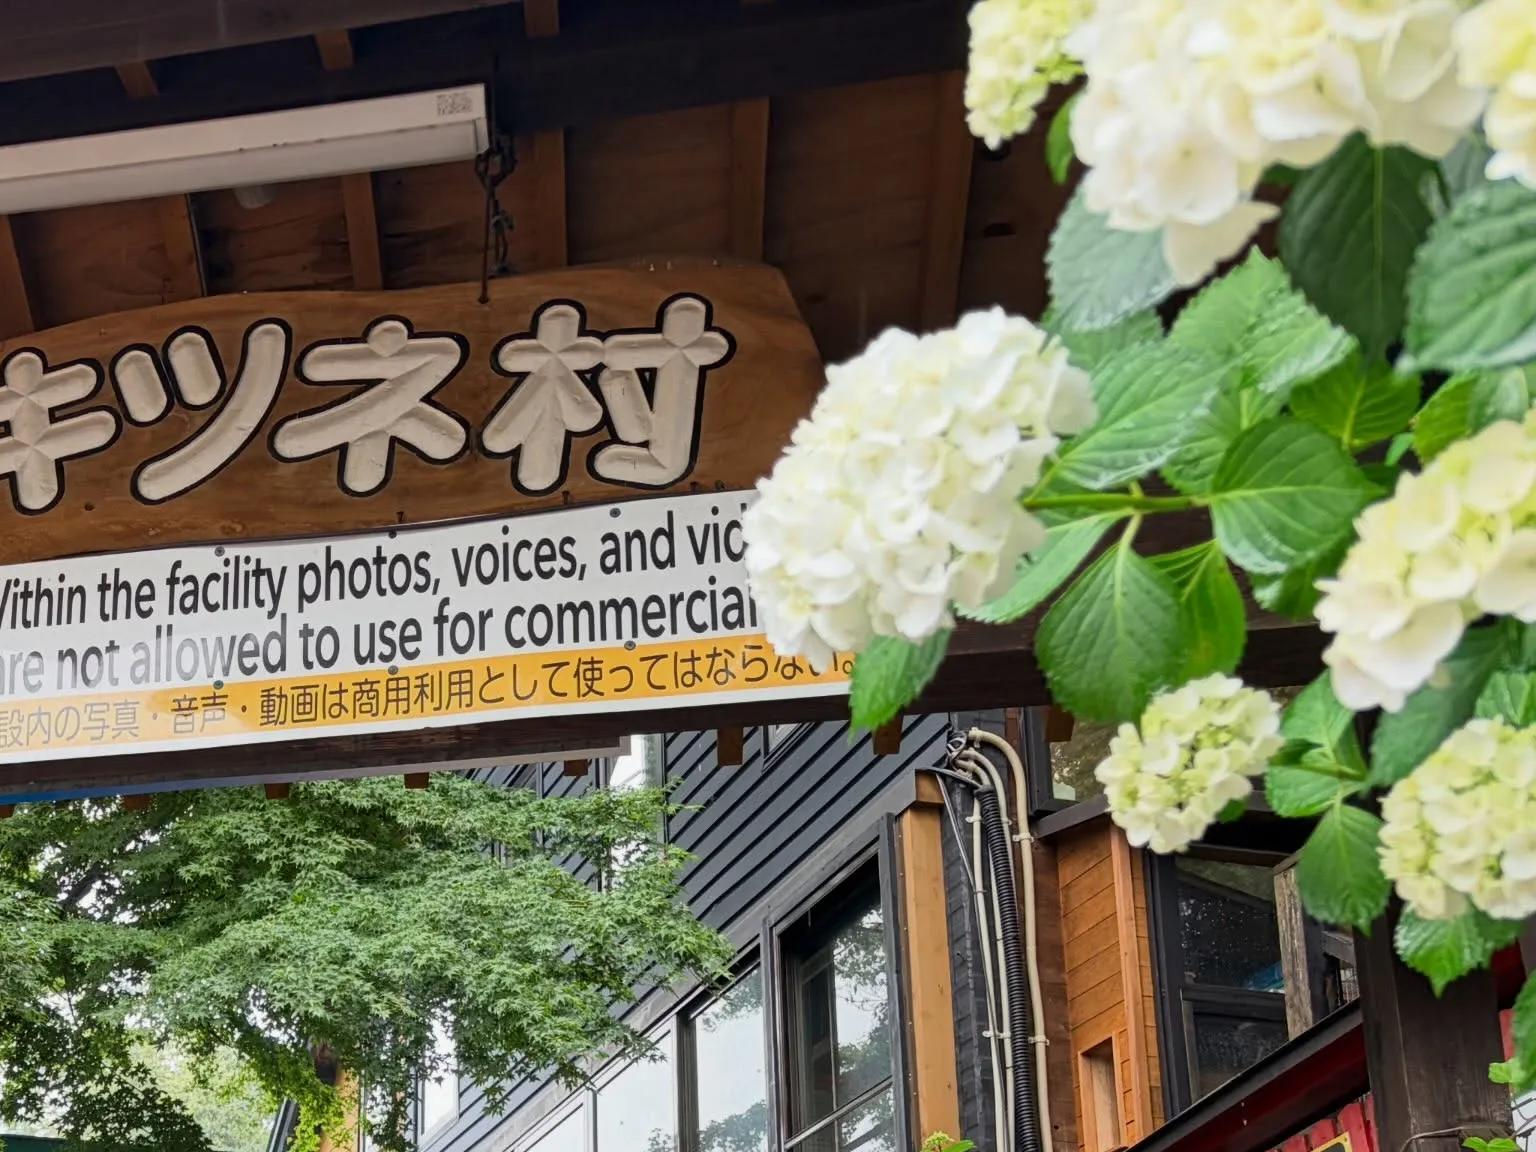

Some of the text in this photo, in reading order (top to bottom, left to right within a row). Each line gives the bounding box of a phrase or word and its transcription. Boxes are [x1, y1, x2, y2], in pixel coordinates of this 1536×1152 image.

[97, 567, 155, 623] the
[165, 555, 288, 624] facility
[297, 545, 442, 613] photos,
[451, 525, 588, 587] voices,
[598, 510, 676, 575] and
[686, 502, 750, 566] vid
[56, 639, 121, 689] not
[129, 613, 288, 685] allowed
[298, 620, 341, 670] to
[352, 616, 423, 667] use
[432, 597, 494, 657] for
[504, 575, 758, 651] commercial
